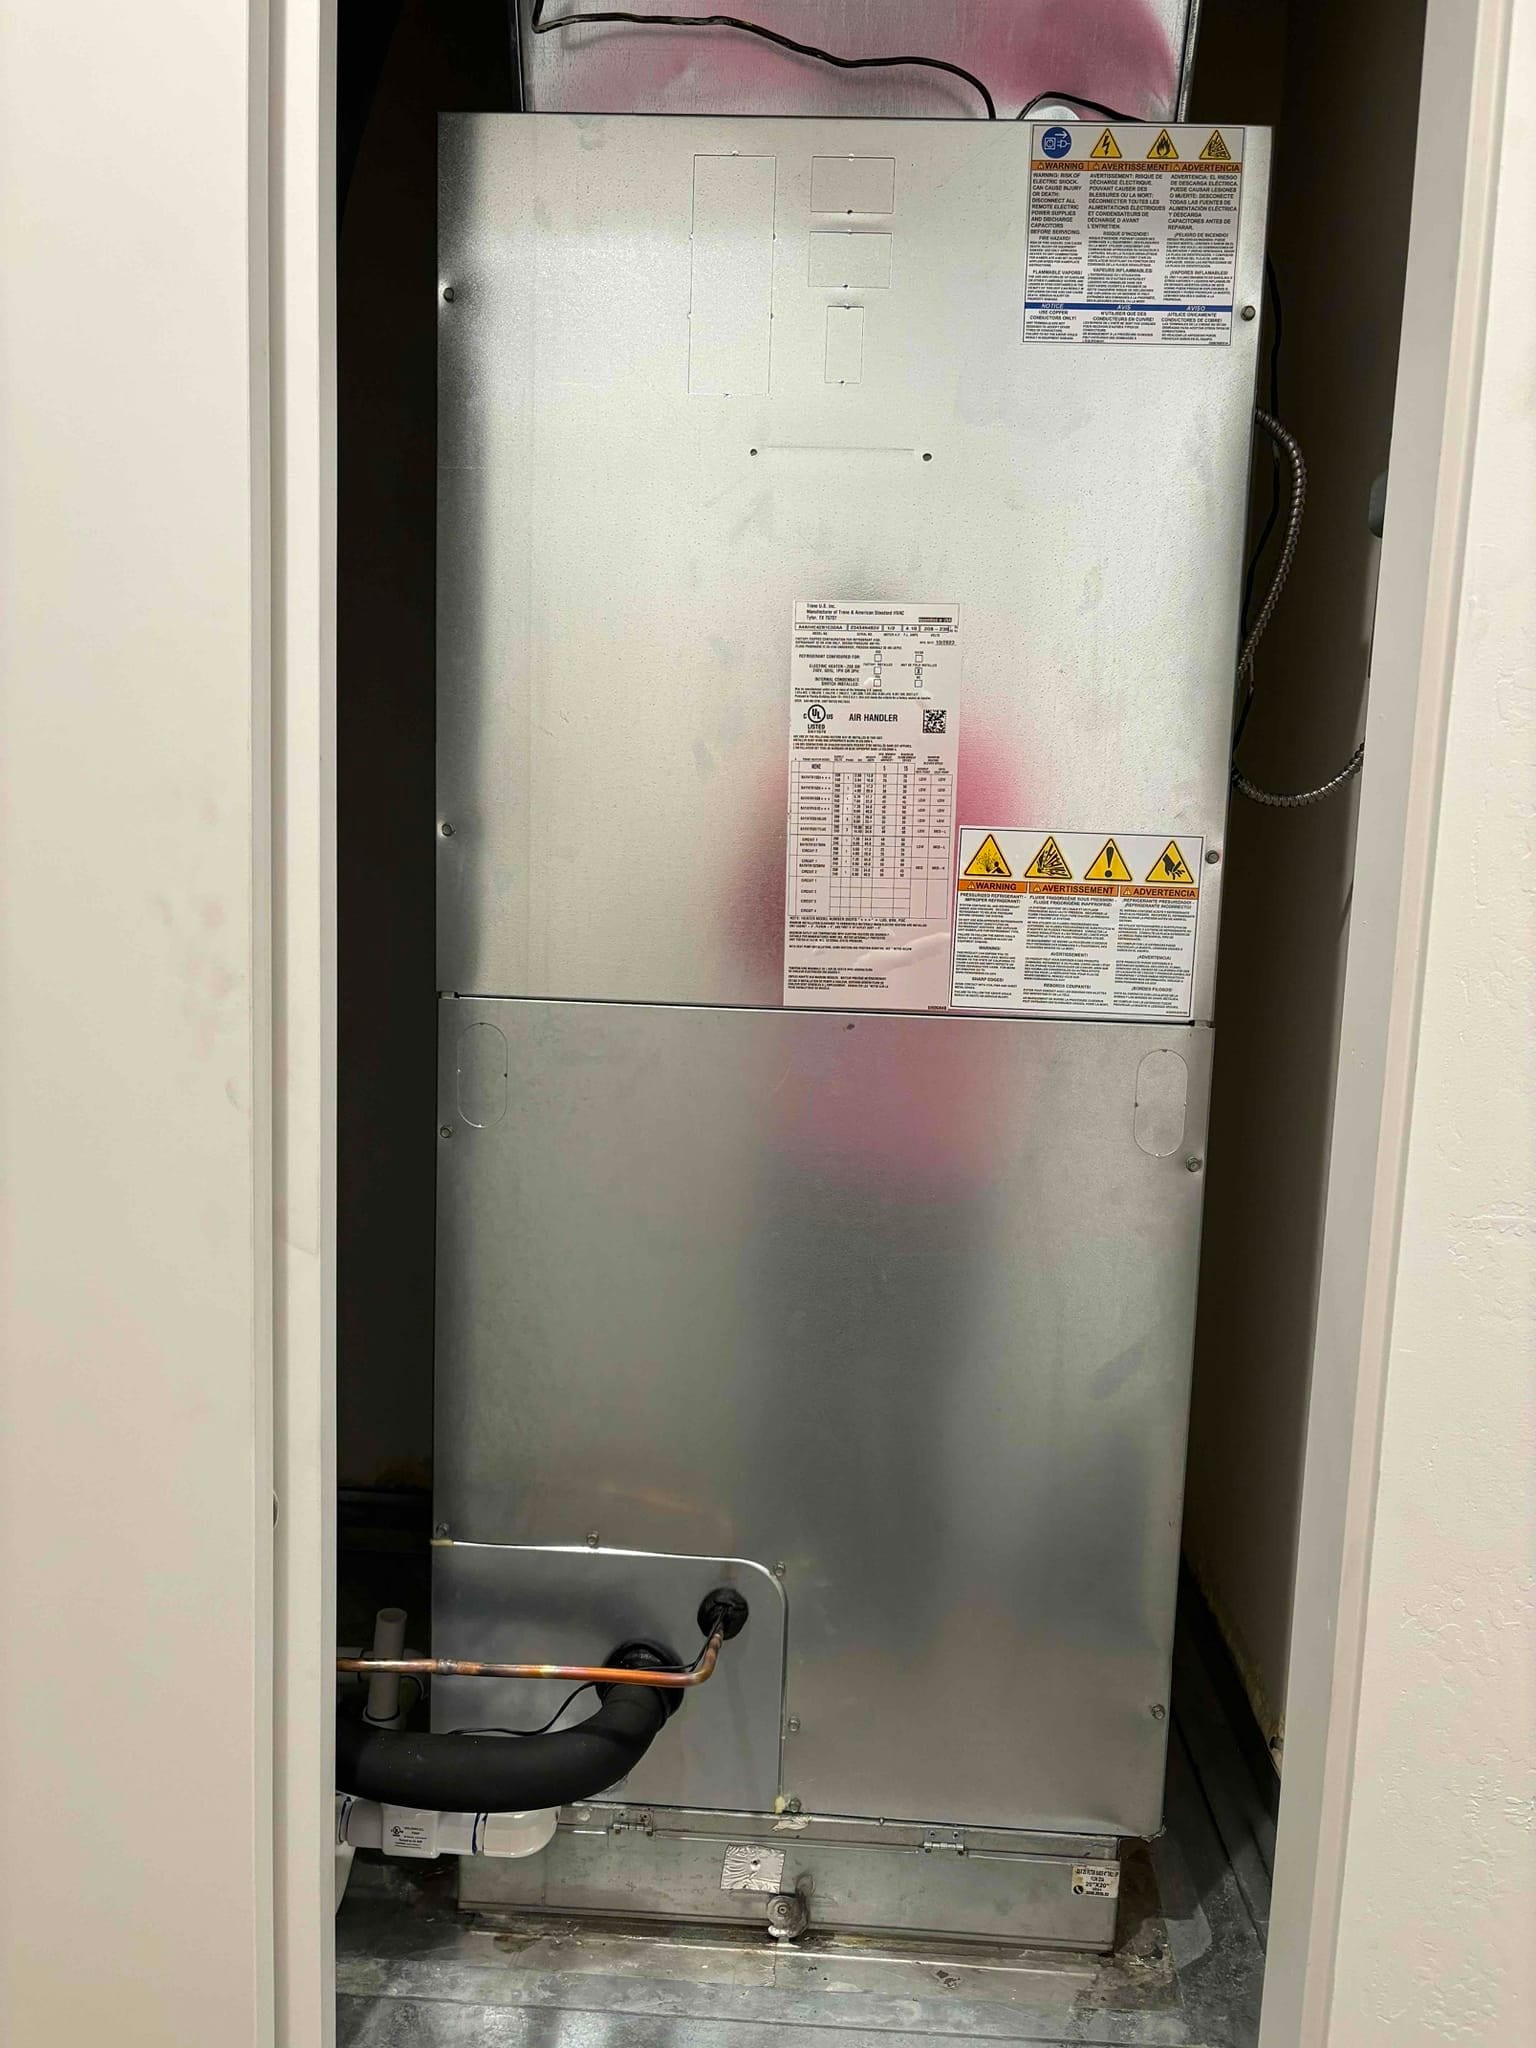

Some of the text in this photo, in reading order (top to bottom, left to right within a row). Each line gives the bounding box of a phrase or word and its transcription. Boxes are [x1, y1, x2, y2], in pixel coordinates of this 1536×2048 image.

[1101, 163, 1168, 171] AVERTISSEMENT
[811, 708, 821, 719] UL
[849, 713, 898, 722] AIR HANDLER
[1042, 885, 1114, 894] AVERTISSEMENT
[1133, 888, 1196, 897] ADVERTENCIA
